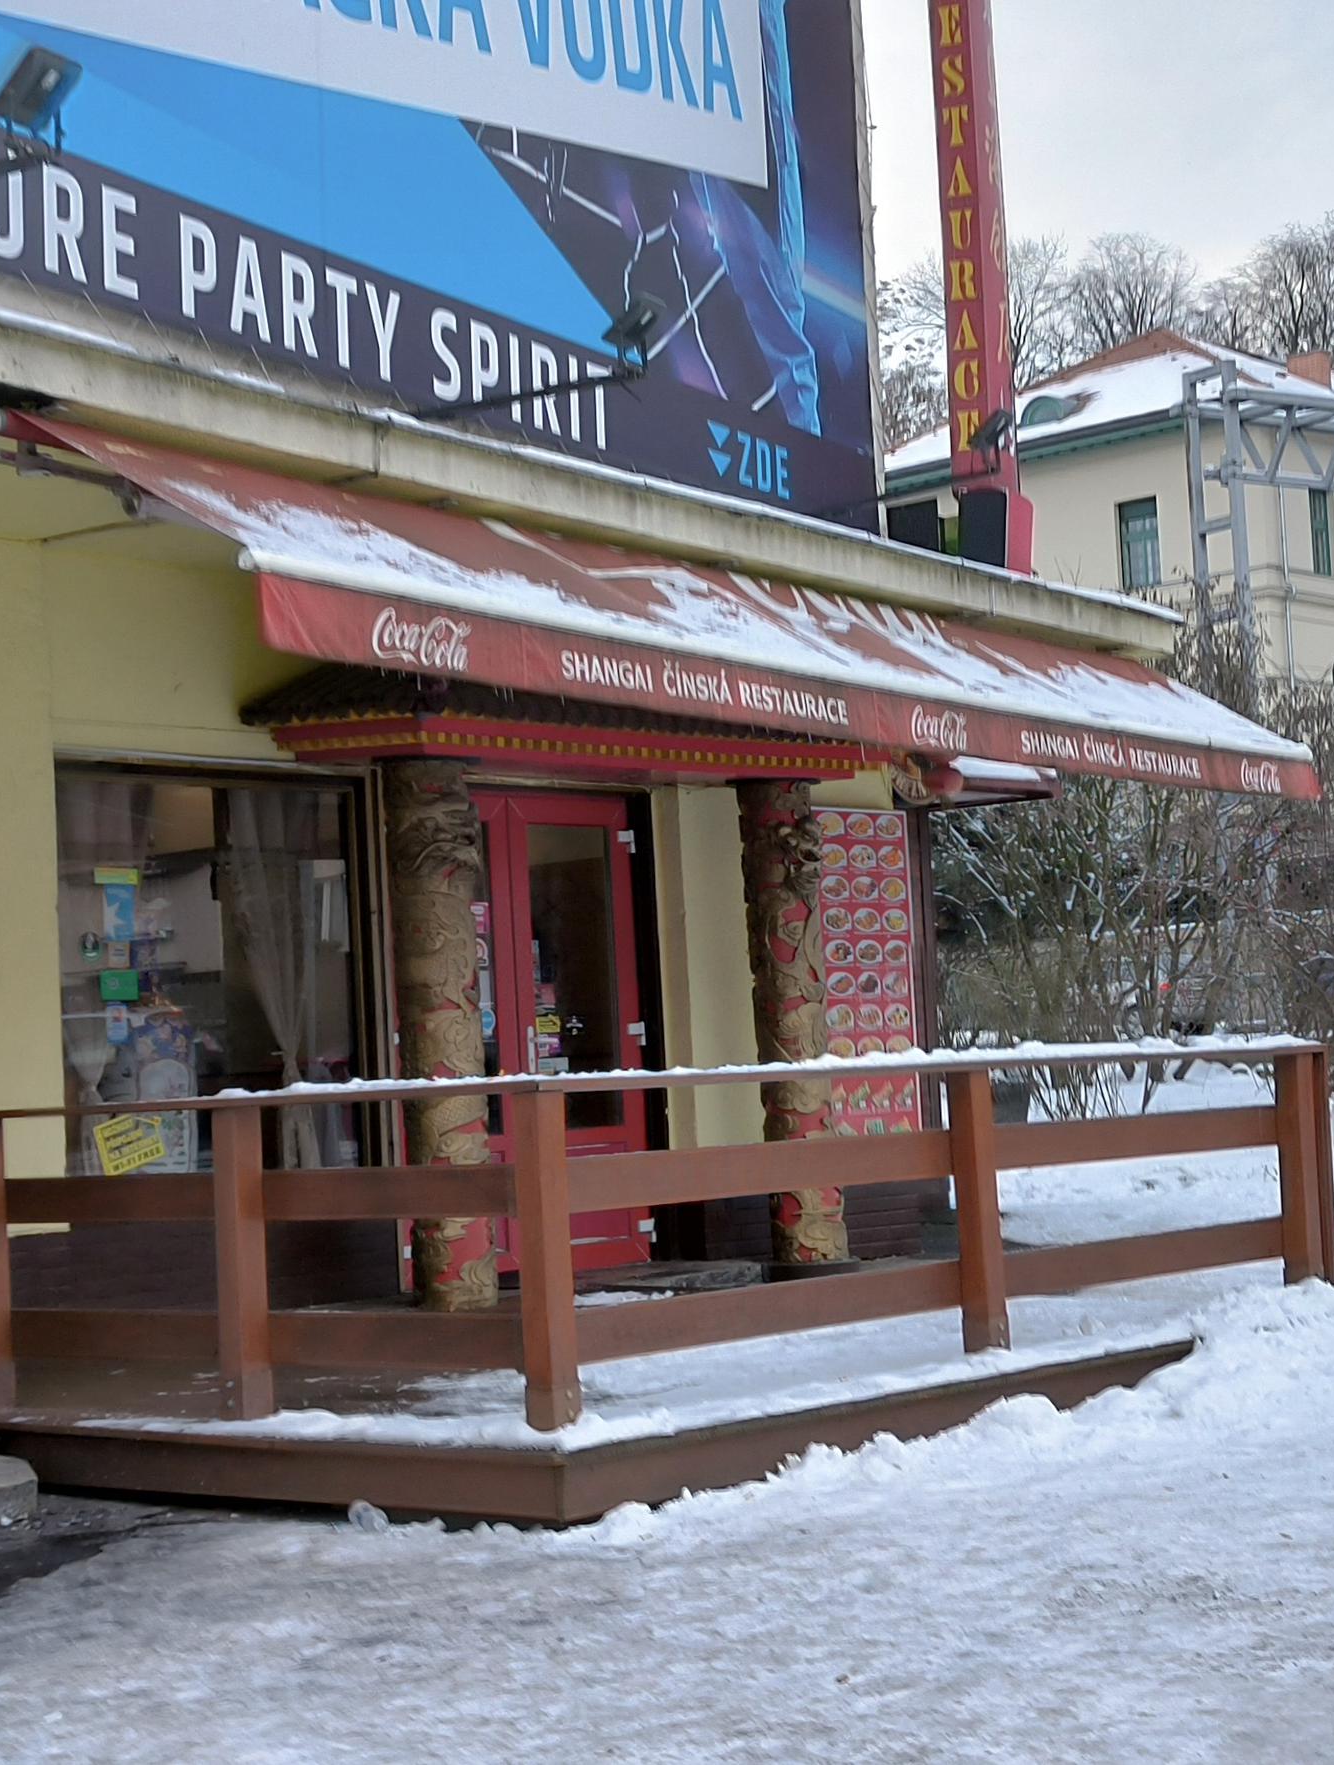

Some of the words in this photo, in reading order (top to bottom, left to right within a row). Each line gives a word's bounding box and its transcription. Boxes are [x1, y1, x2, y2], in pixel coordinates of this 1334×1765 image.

[178, 211, 401, 383] PARTY
[429, 306, 613, 452] SPIRIT
[736, 429, 791, 501] ZDE
[371, 606, 472, 673] Coca-Cola
[561, 650, 654, 694] SHANGAI
[662, 658, 734, 707] ČÍNSKÁ
[738, 679, 850, 727] RESTAURACE
[910, 703, 968, 753] Coca-Cola
[1020, 729, 1080, 762] SHANGAI
[1082, 732, 1127, 769] ČÍNSKÁ
[1128, 746, 1202, 780] RESTAURACE
